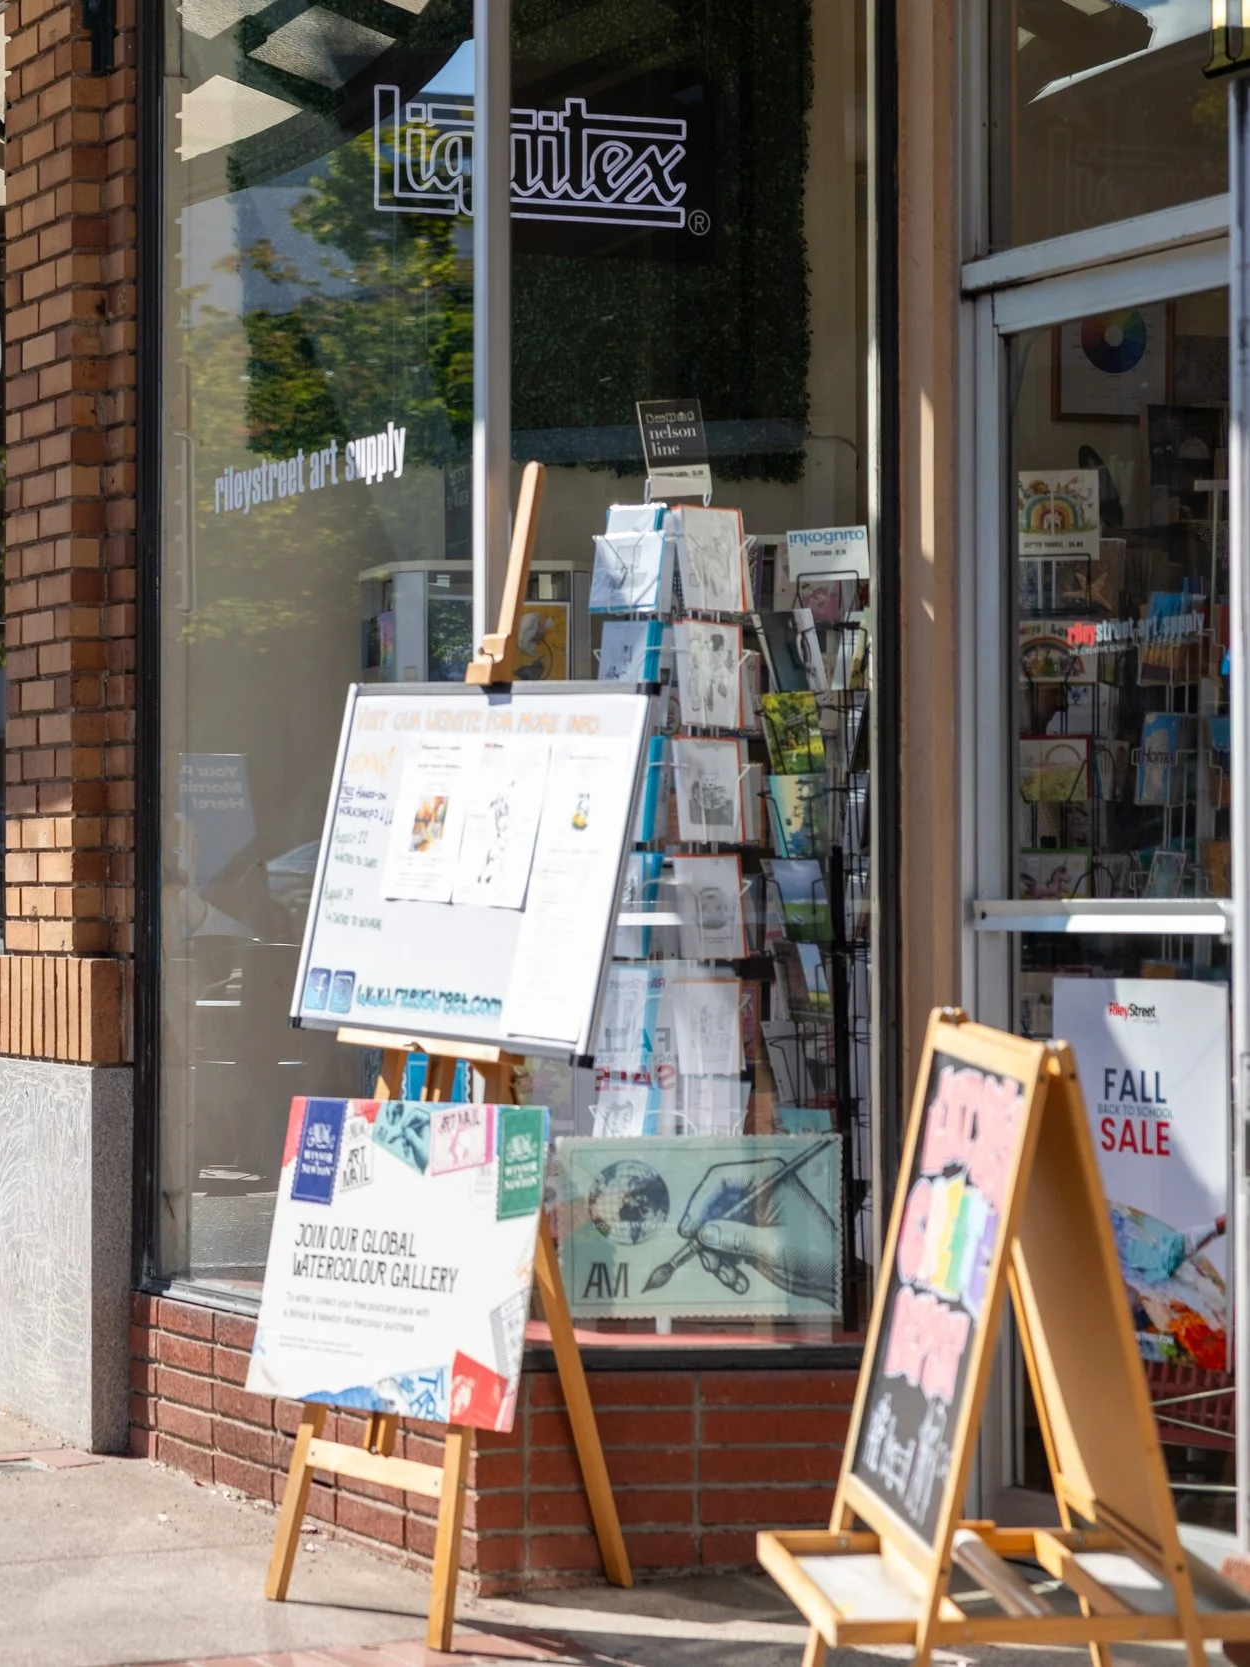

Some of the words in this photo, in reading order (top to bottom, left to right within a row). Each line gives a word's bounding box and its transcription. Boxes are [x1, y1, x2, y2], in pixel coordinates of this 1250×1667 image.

[374, 85, 687, 228] Liquitex
[649, 424, 697, 440] nelson
[651, 440, 680, 457] line
[215, 448, 305, 514] rileystreet
[310, 439, 338, 490] art
[345, 421, 406, 485] supply
[1104, 1068, 1167, 1104] FALL
[1098, 1104, 1120, 1115] BACK
[1123, 1105, 1134, 1116] TO
[1137, 1106, 1174, 1119] SCHOOL
[1101, 1116, 1171, 1157] SALE
[346, 1145, 367, 1168] ART
[295, 1223, 327, 1249] JOIN
[329, 1226, 359, 1252] OUR
[361, 1228, 417, 1257] GLOBAL
[292, 1252, 388, 1286] WATERCOLOUR
[390, 1262, 459, 1294] GALLERY
